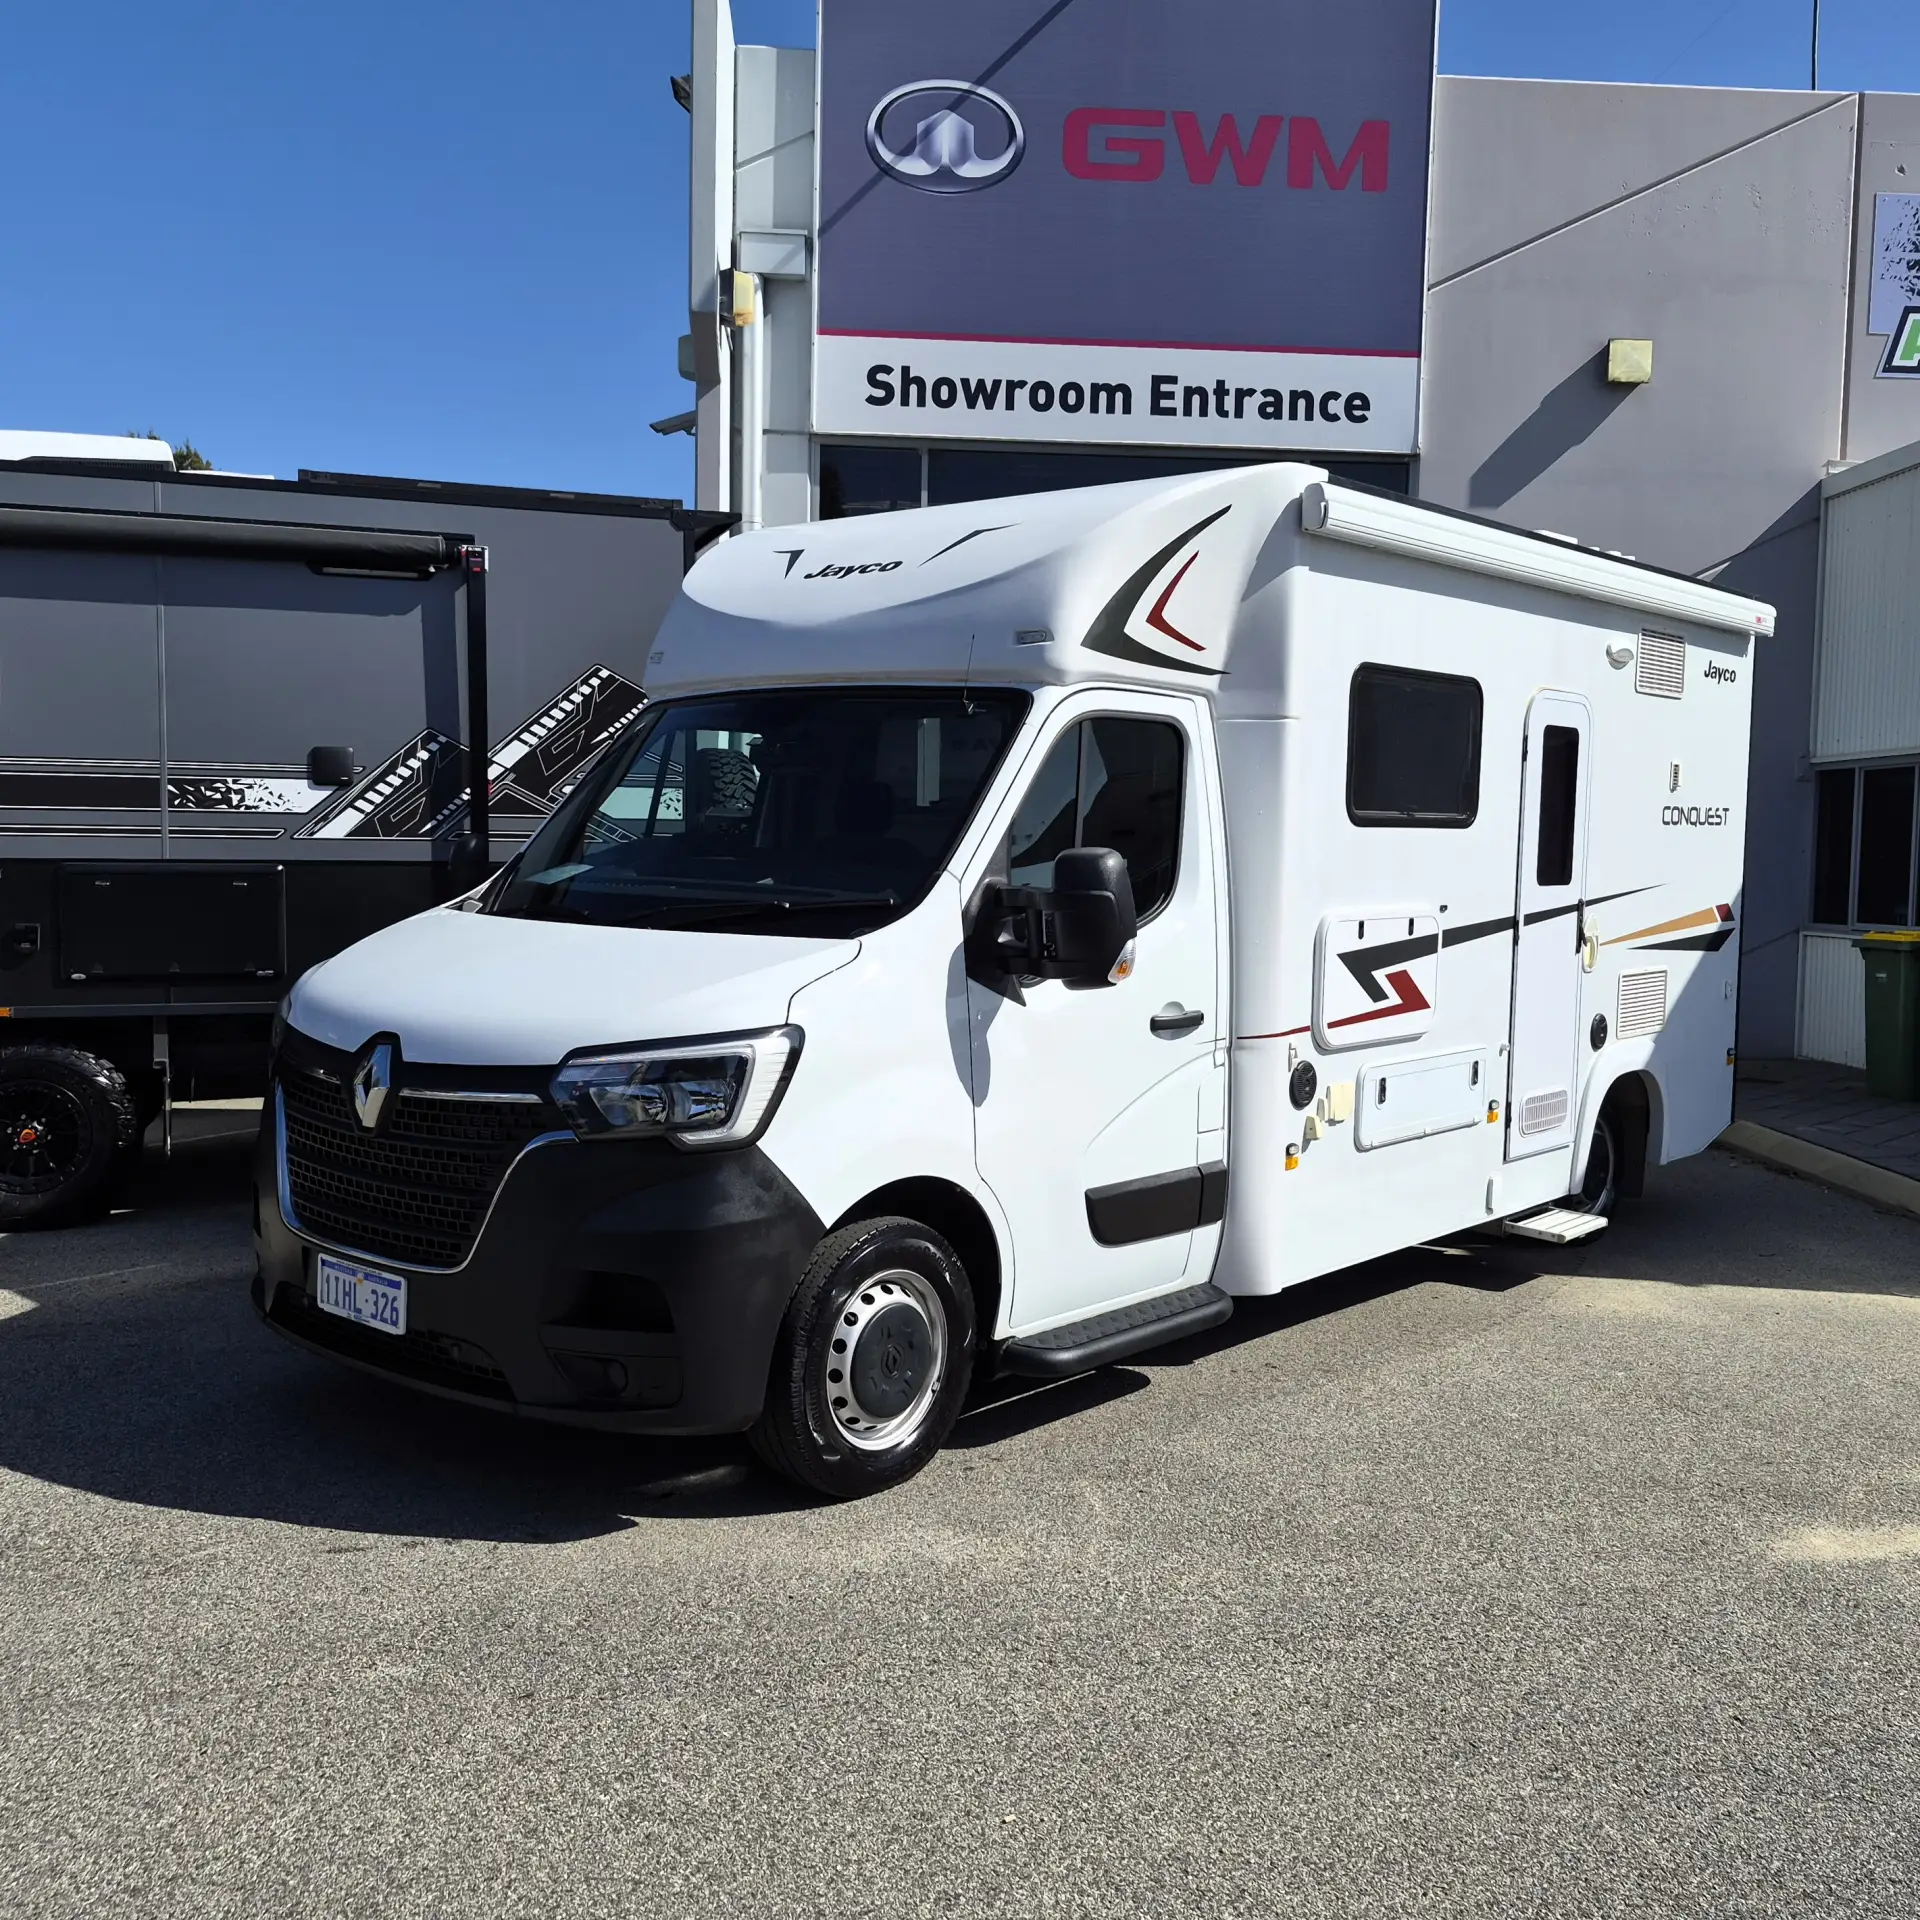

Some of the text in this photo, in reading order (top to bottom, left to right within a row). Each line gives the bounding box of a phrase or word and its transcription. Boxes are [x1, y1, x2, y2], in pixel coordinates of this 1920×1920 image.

[1063, 106, 1390, 192] GWM
[865, 364, 1371, 424] Showroom Entrance
[803, 560, 904, 580] Jayco
[1704, 660, 1737, 685] Jayco
[1662, 805, 1730, 828] CONQUEST
